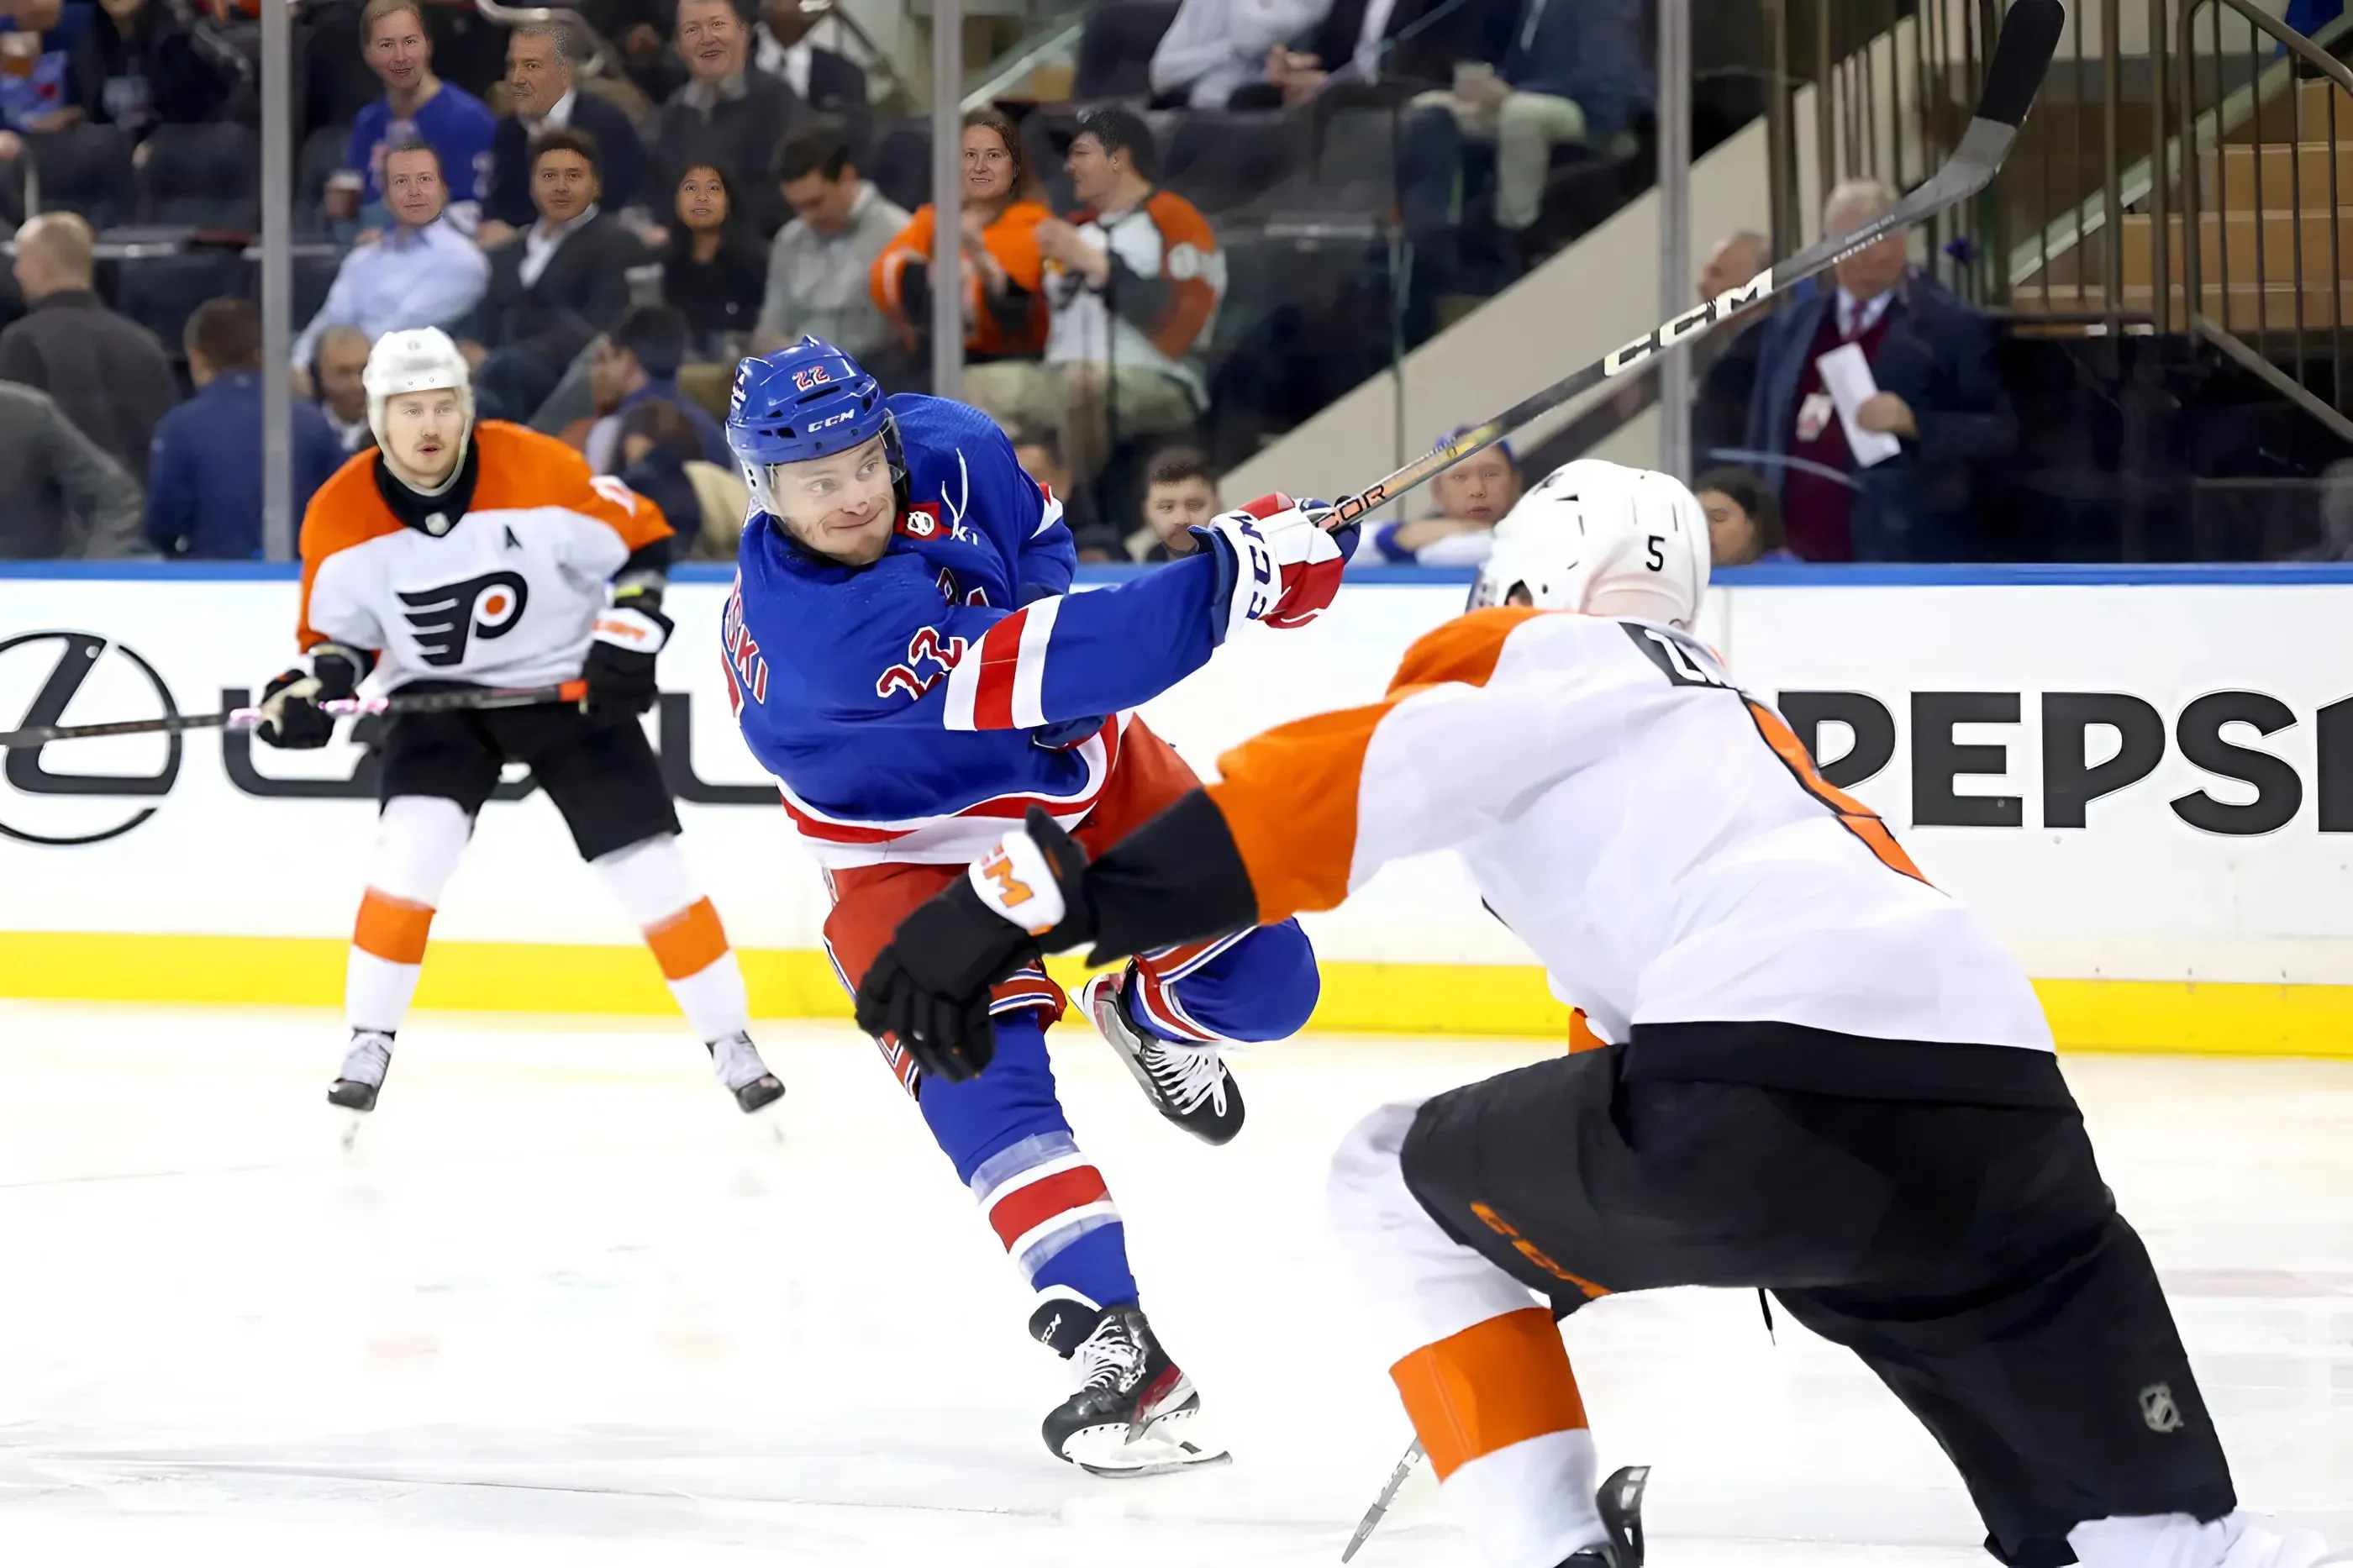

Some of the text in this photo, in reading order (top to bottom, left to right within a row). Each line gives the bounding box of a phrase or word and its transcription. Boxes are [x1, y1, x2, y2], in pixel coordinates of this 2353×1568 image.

[1604, 266, 1773, 377] CCM
[792, 366, 830, 392] 22
[808, 408, 855, 433] CCM
[1229, 514, 1272, 620] CCM
[1645, 534, 1666, 571] 5
[876, 625, 969, 701] 22
[1777, 688, 2353, 837] PEPSI
